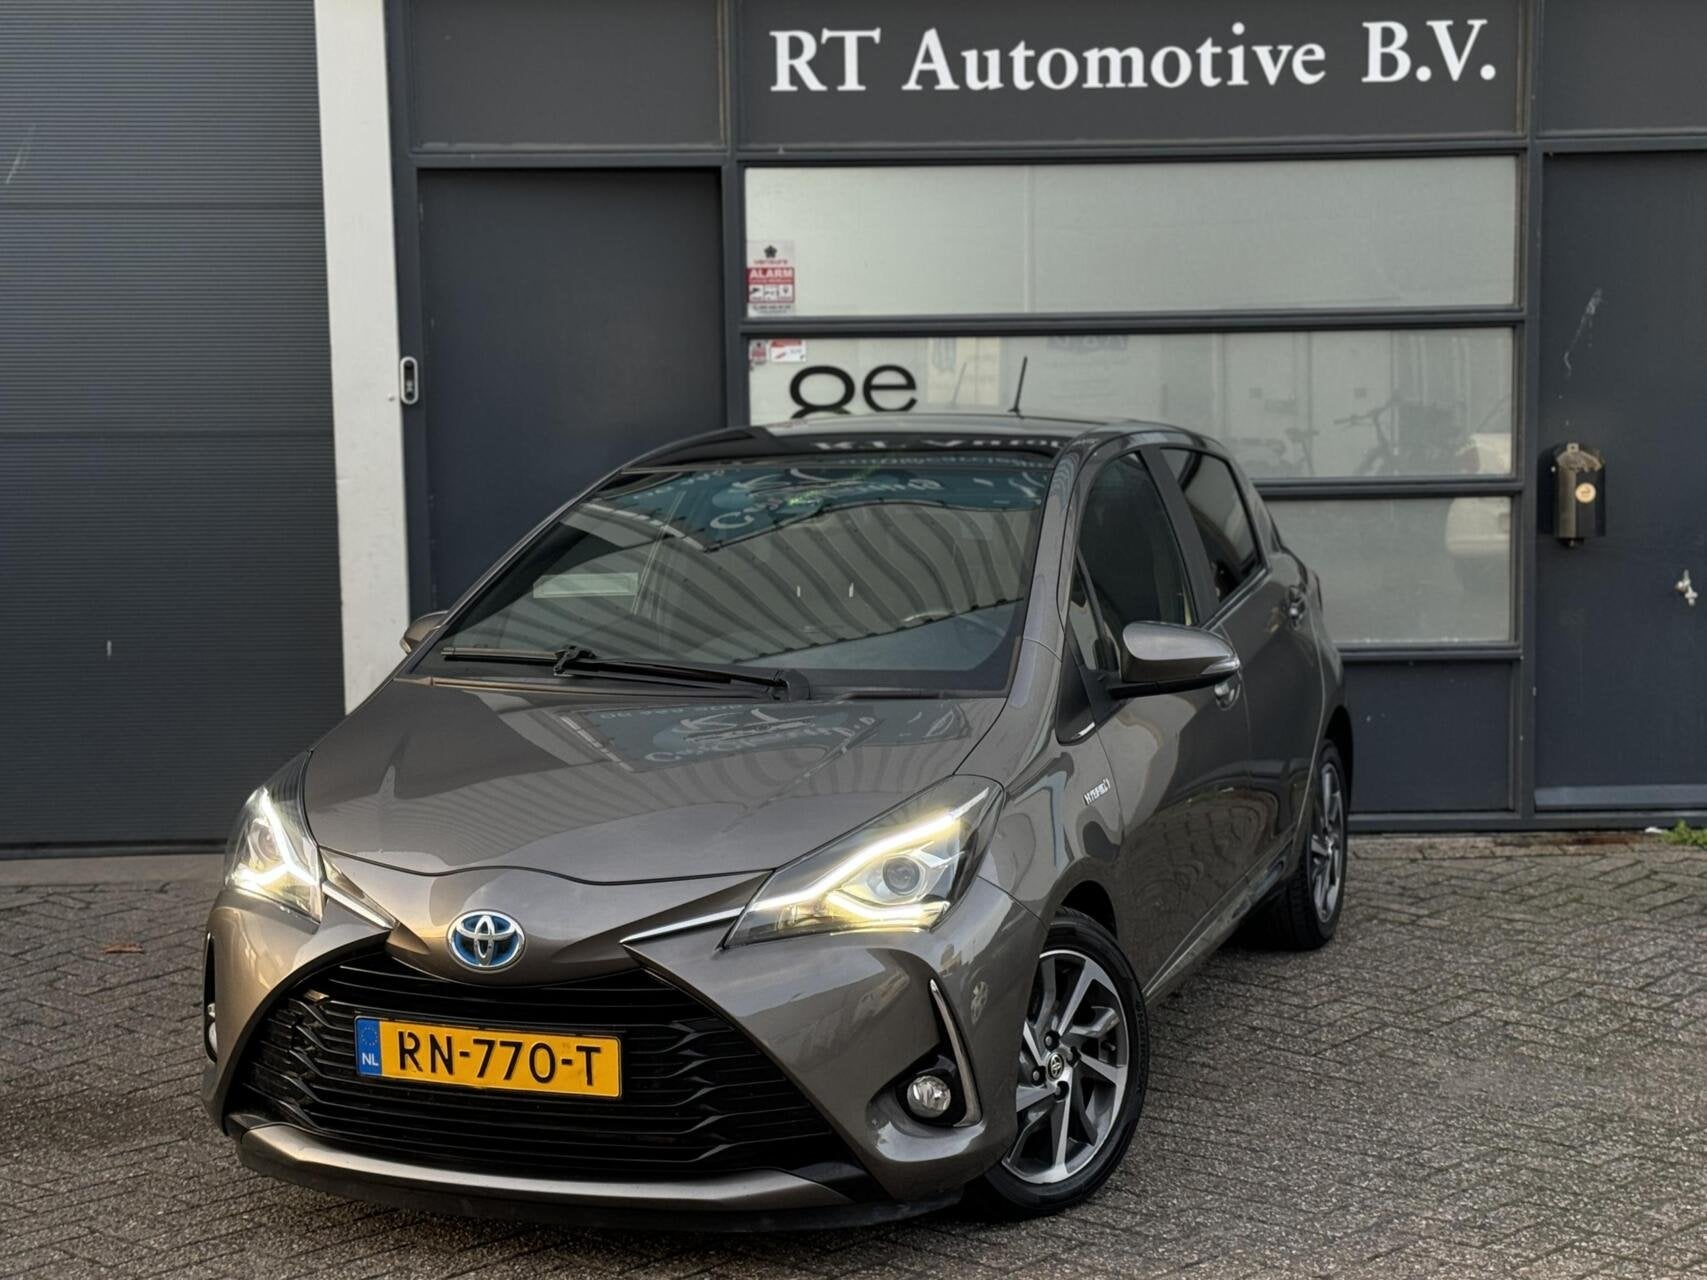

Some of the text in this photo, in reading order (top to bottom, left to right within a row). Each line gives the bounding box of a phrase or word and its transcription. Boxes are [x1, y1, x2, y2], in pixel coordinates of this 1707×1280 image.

[769, 19, 1496, 92] RT Automotive B.V.
[750, 268, 792, 278] ALARM
[361, 1052, 379, 1067] NL
[397, 1030, 602, 1087] RN-770-T
